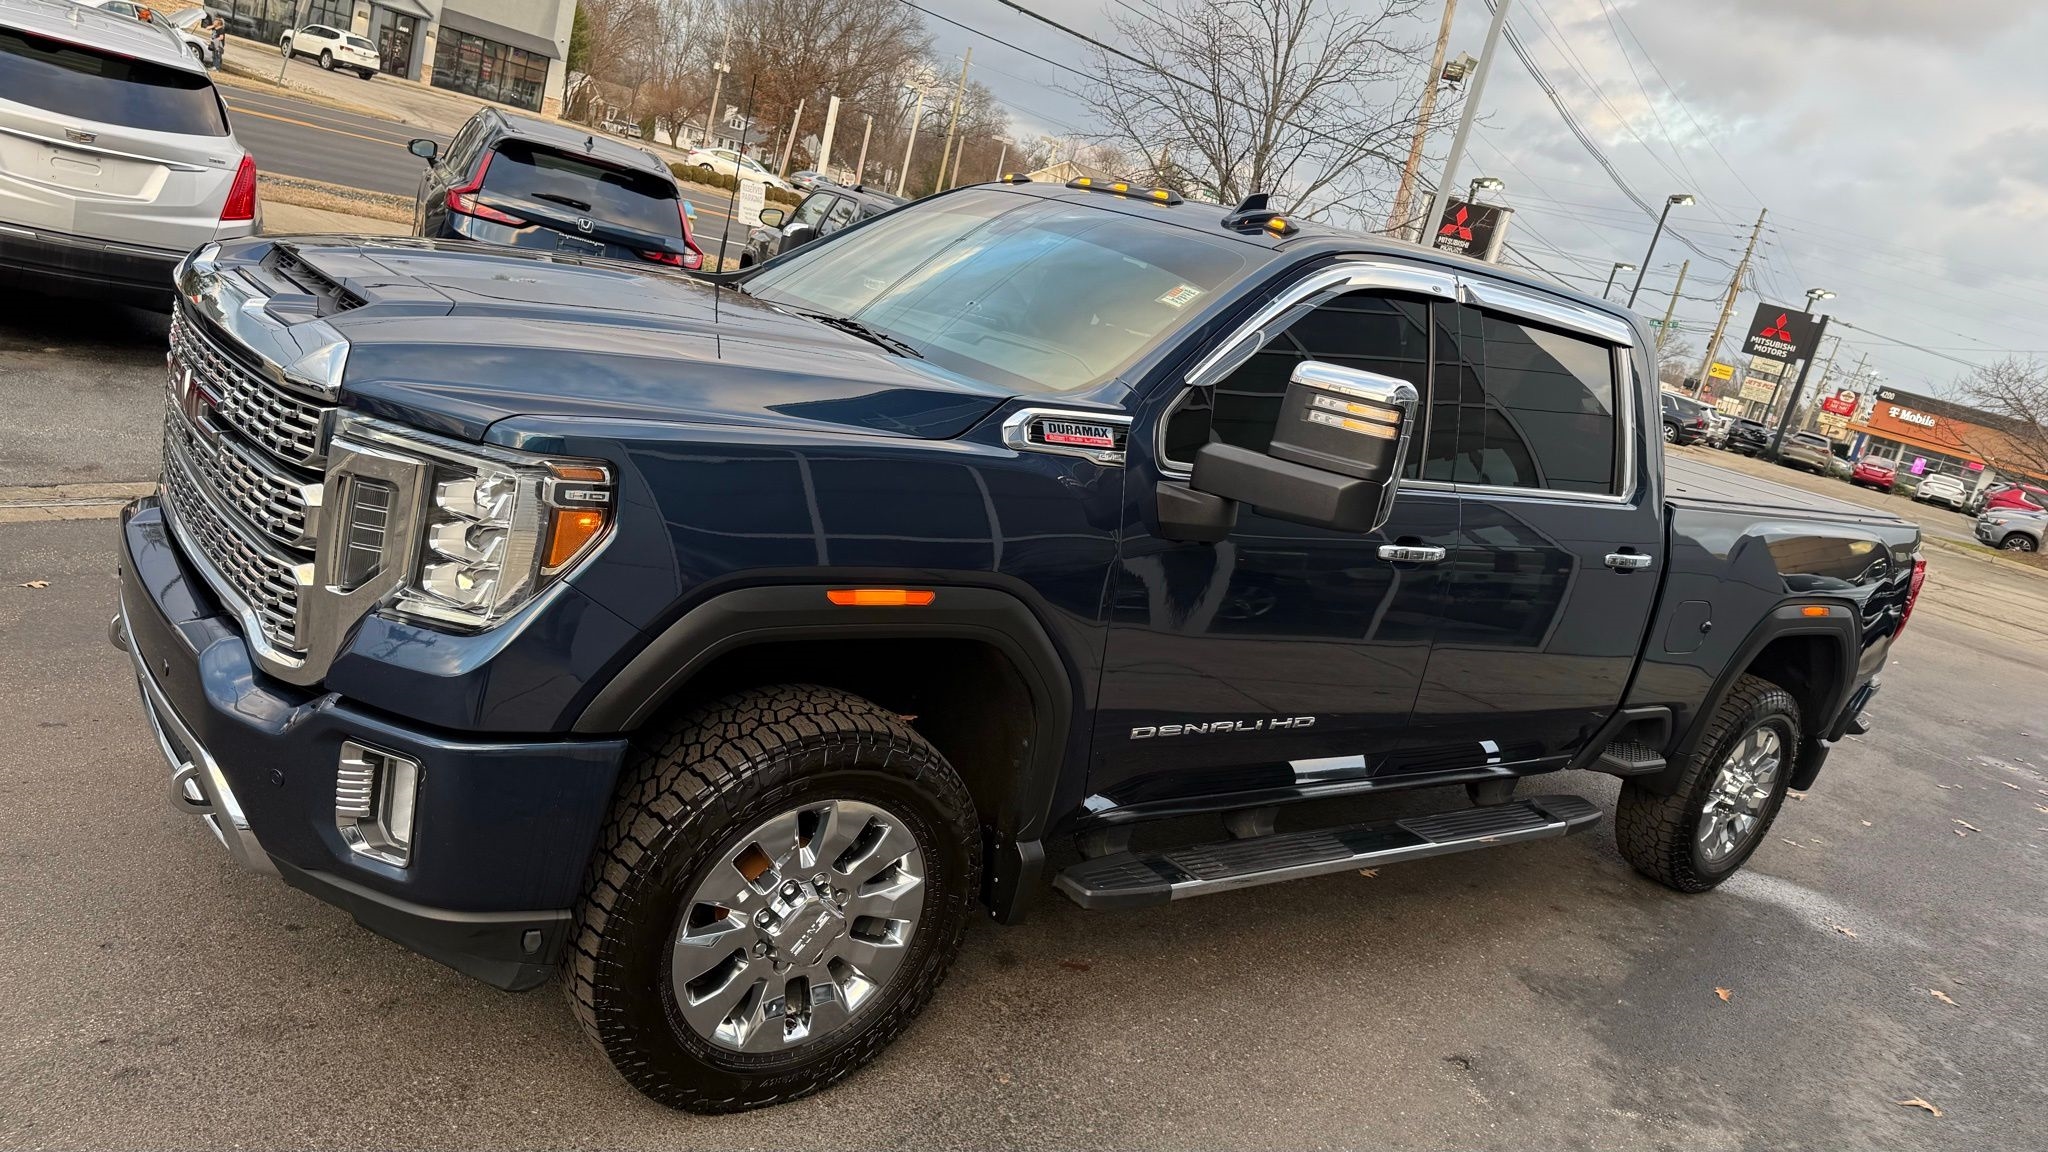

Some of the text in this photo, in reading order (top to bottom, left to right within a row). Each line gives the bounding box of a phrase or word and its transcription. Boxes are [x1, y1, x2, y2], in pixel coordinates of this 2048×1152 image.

[1750, 336, 1796, 352] MITSUBISHI
[1753, 344, 1788, 358] MOTORS
[1047, 422, 1109, 438] DURAMAX
[1130, 716, 1316, 740] DENALI HD
